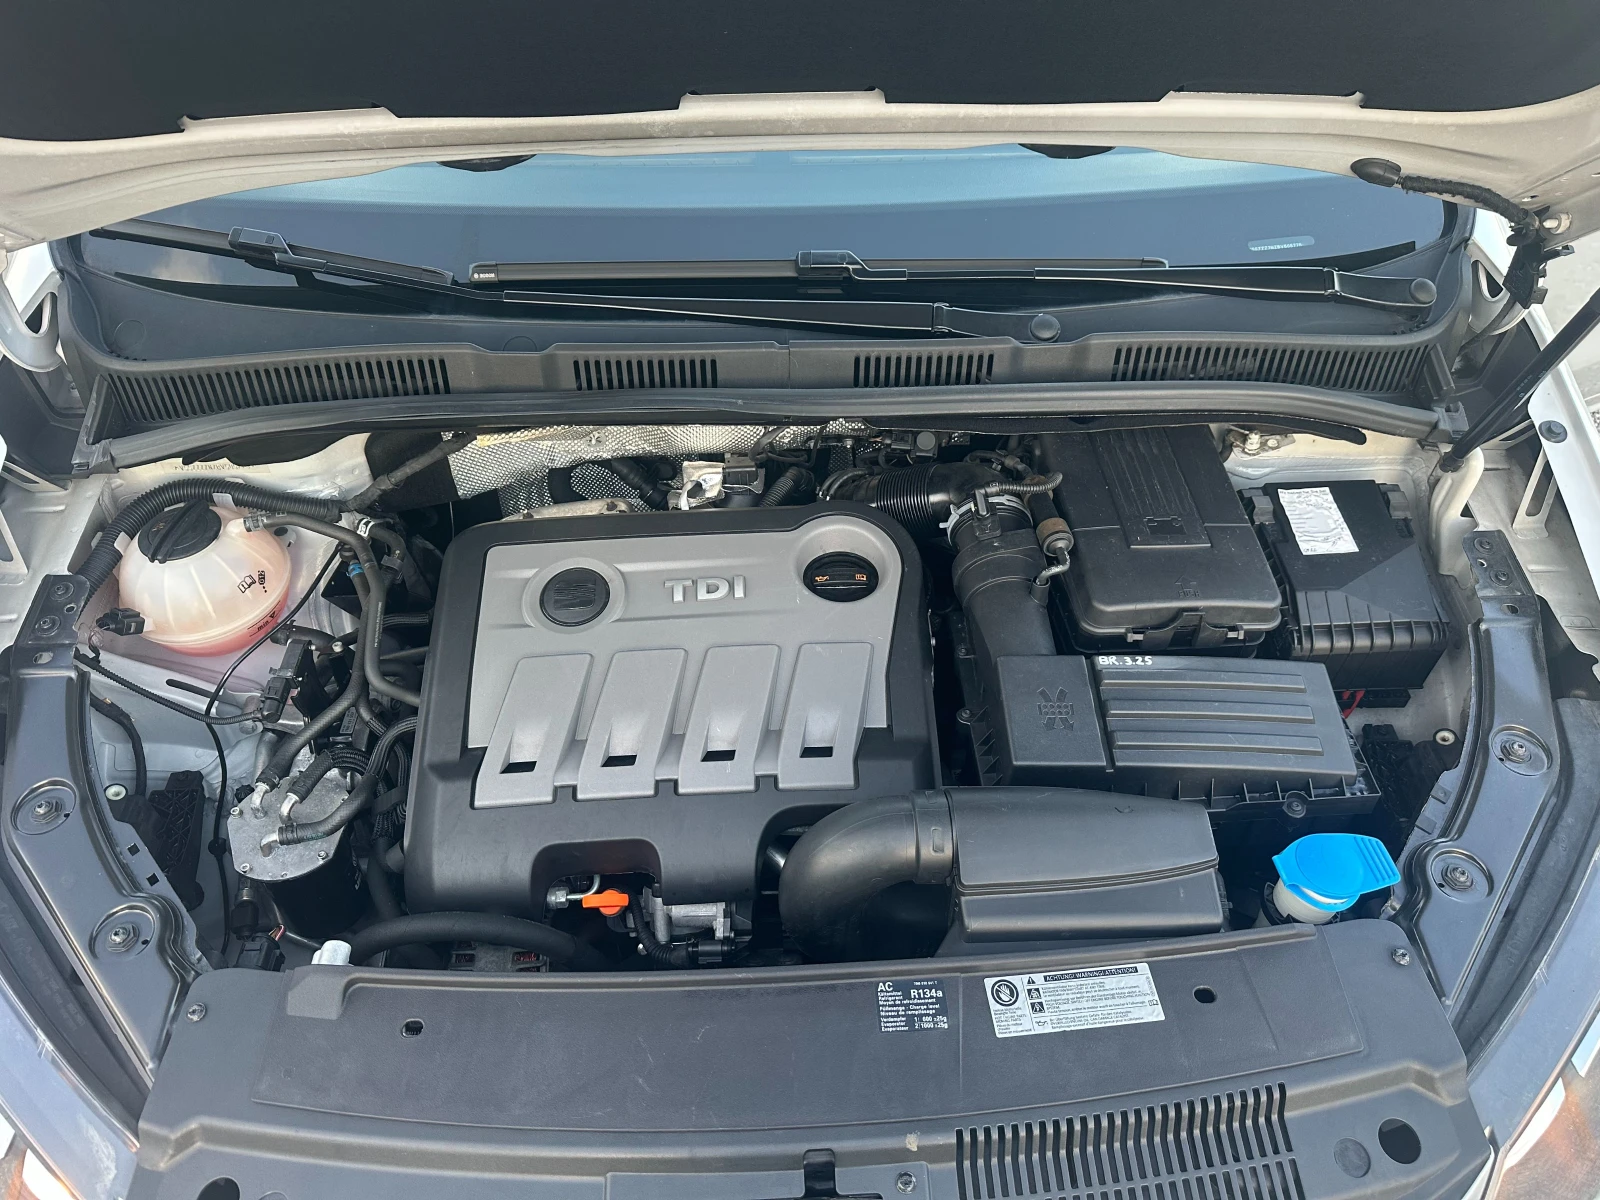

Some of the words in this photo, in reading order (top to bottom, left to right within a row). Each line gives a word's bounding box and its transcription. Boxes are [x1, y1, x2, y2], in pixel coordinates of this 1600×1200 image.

[664, 575, 746, 603] TDI
[257, 621, 269, 631] min
[877, 982, 893, 991] AC
[910, 988, 943, 998] R134a
